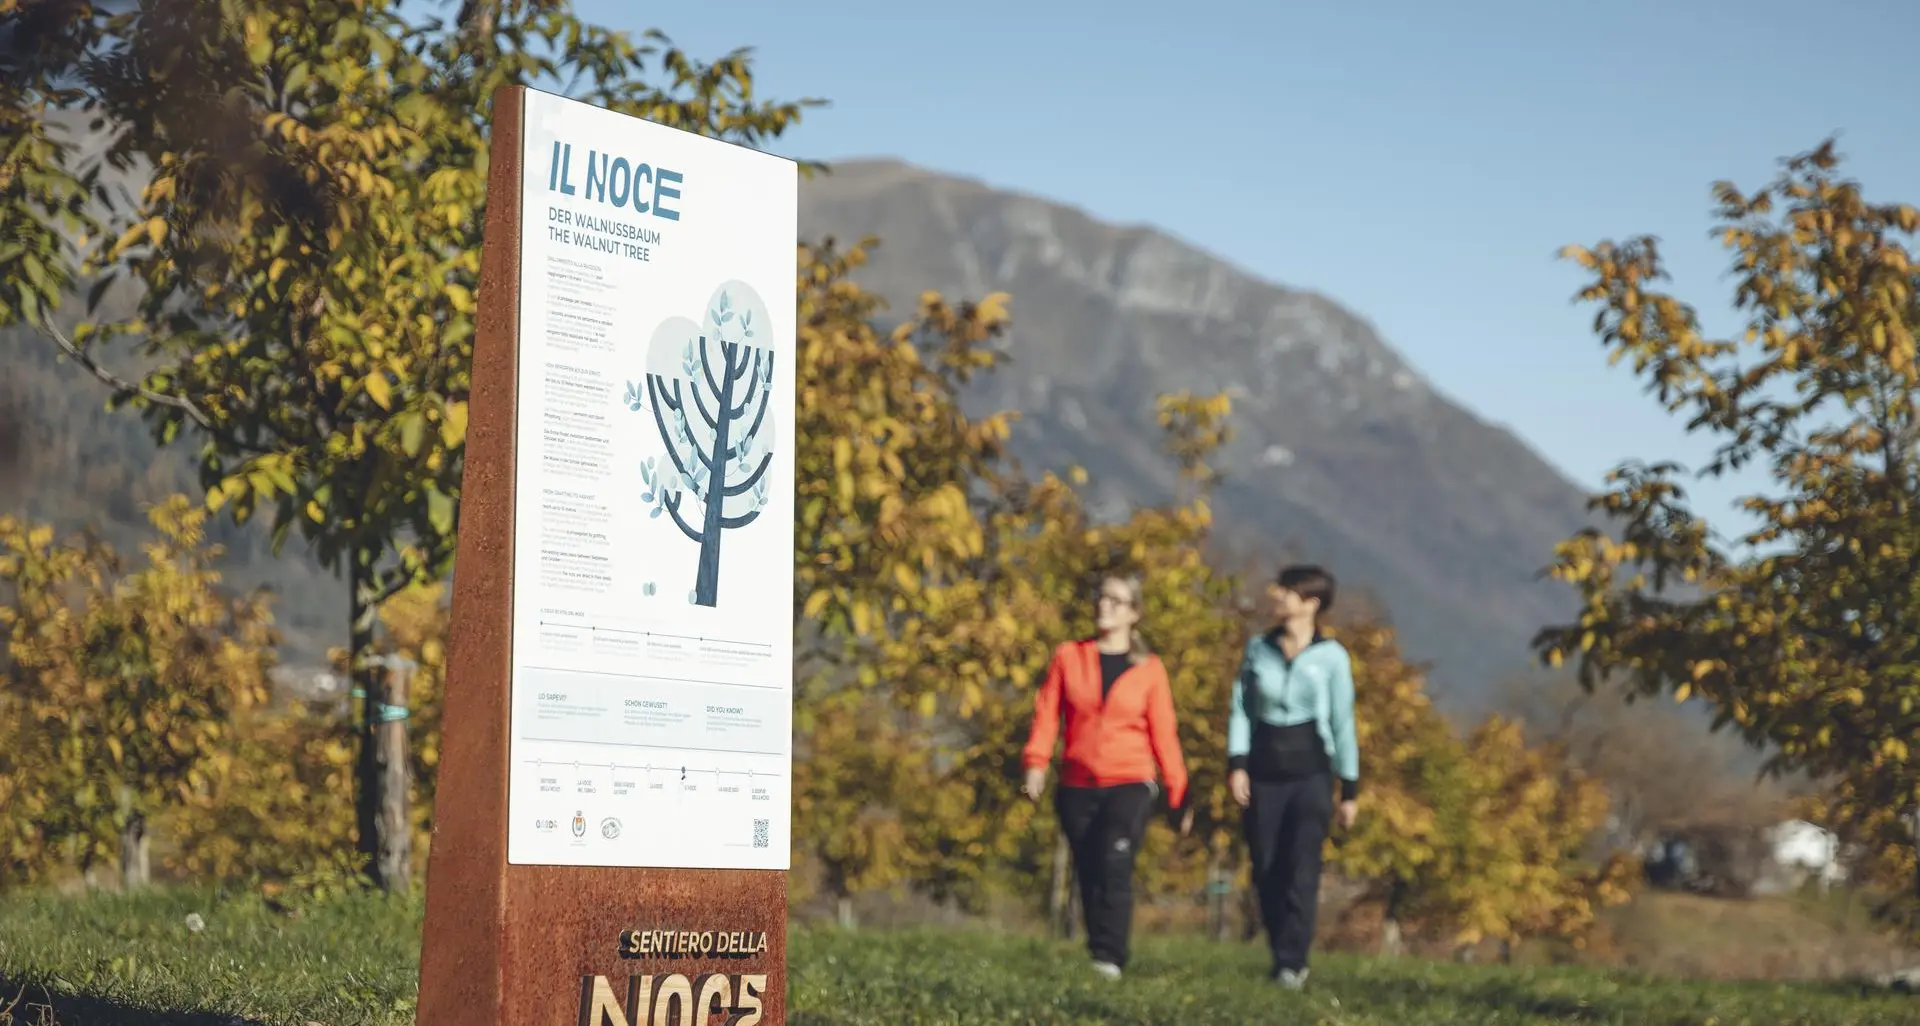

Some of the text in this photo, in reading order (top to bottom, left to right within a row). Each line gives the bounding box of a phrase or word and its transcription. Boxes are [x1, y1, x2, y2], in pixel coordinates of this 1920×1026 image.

[549, 140, 684, 221] IL NOCE
[548, 225, 650, 262] THE WALNUT TREE
[549, 206, 661, 246] DER WALNUSSBAUM
[629, 930, 768, 954] SENTIERO DELLA
